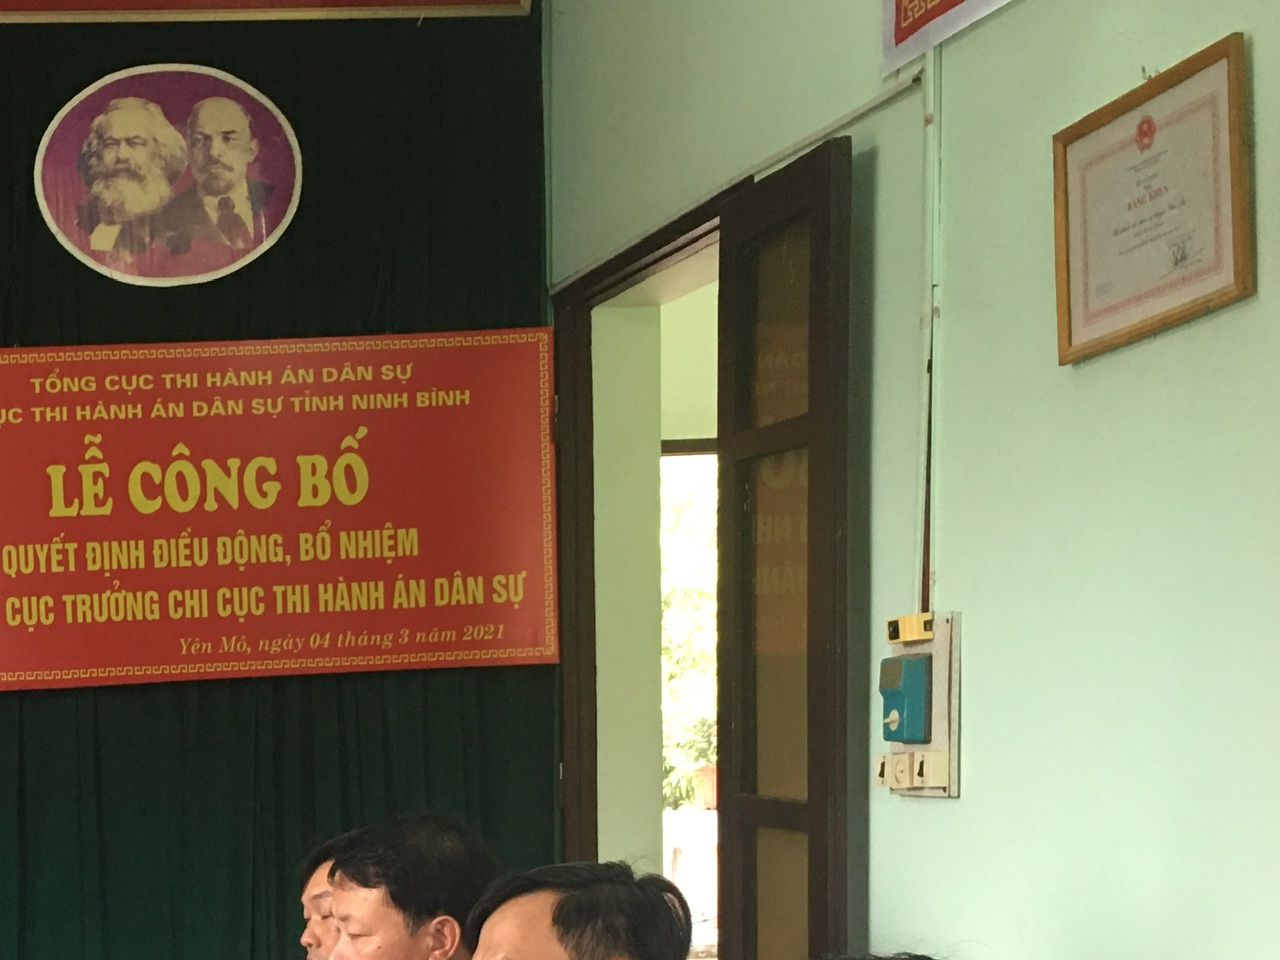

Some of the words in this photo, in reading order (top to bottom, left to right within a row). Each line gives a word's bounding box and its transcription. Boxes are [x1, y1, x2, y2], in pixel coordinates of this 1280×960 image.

[30, 367, 98, 395] TỔNG
[104, 373, 155, 395] CỤC
[161, 372, 199, 390] THI
[206, 366, 274, 389] HÀNH
[280, 364, 315, 386] ÁN
[321, 361, 374, 384] DÂN
[381, 361, 414, 384] SỰ
[30, 405, 69, 424] THI
[75, 399, 144, 422] HÀNH
[150, 397, 186, 419] ÁN
[192, 395, 245, 418] DÂN
[251, 394, 285, 419] SỰ
[289, 389, 345, 414] TỈNH
[351, 391, 409, 411] NINH
[416, 387, 471, 409] BÌNH
[46, 432, 114, 519] LỄ
[127, 441, 283, 516] CÔNG
[295, 424, 370, 509] BỐ
[2, 531, 79, 579] QUYẾT
[85, 538, 147, 578] ĐỊNH
[152, 526, 210, 570] ĐIỀU
[216, 527, 292, 572] ĐỘNG,
[299, 518, 333, 562] BỔ
[339, 521, 420, 565] NHIỆM
[5, 594, 56, 633] CỤC
[61, 579, 161, 625] TRƯỞNG
[167, 587, 210, 620] CHI
[216, 584, 266, 624] CỤC
[272, 583, 311, 616] THI
[318, 575, 386, 614] HÀNH
[392, 573, 427, 610] ÁN
[434, 569, 485, 607] DÂN
[492, 569, 529, 611] SỰ
[180, 637, 213, 656] Yên
[219, 634, 252, 654] Mô,
[259, 637, 303, 655] ngày
[309, 631, 331, 649] 04
[337, 630, 393, 649] tháng
[399, 628, 410, 644] 3
[416, 630, 457, 643] năm
[463, 623, 505, 641] 2021
